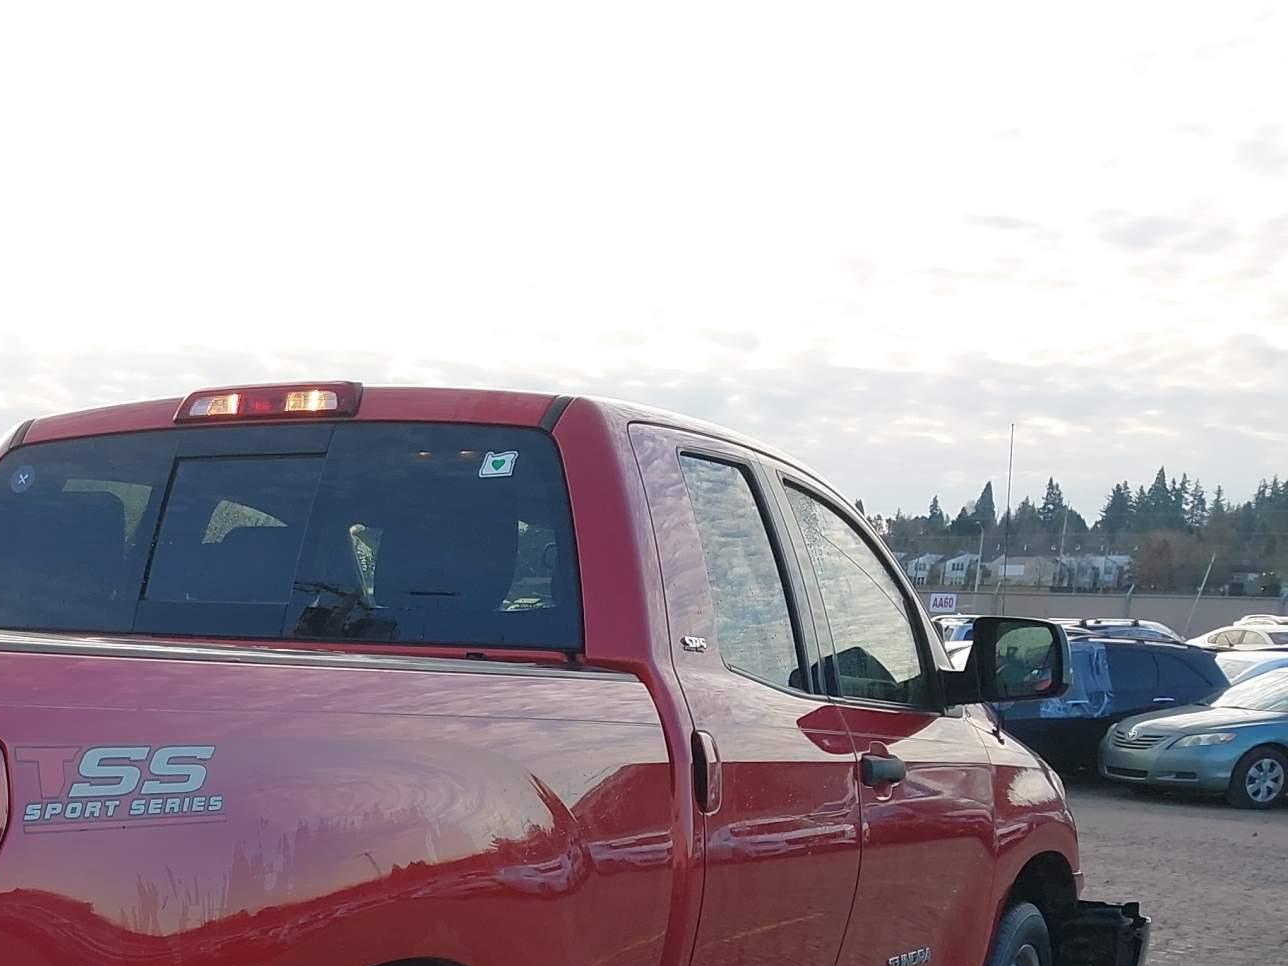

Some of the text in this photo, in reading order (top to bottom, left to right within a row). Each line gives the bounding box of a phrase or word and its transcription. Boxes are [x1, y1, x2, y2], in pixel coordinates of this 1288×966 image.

[932, 597, 955, 609] AA60
[23, 795, 224, 822] SPORT SERIES
